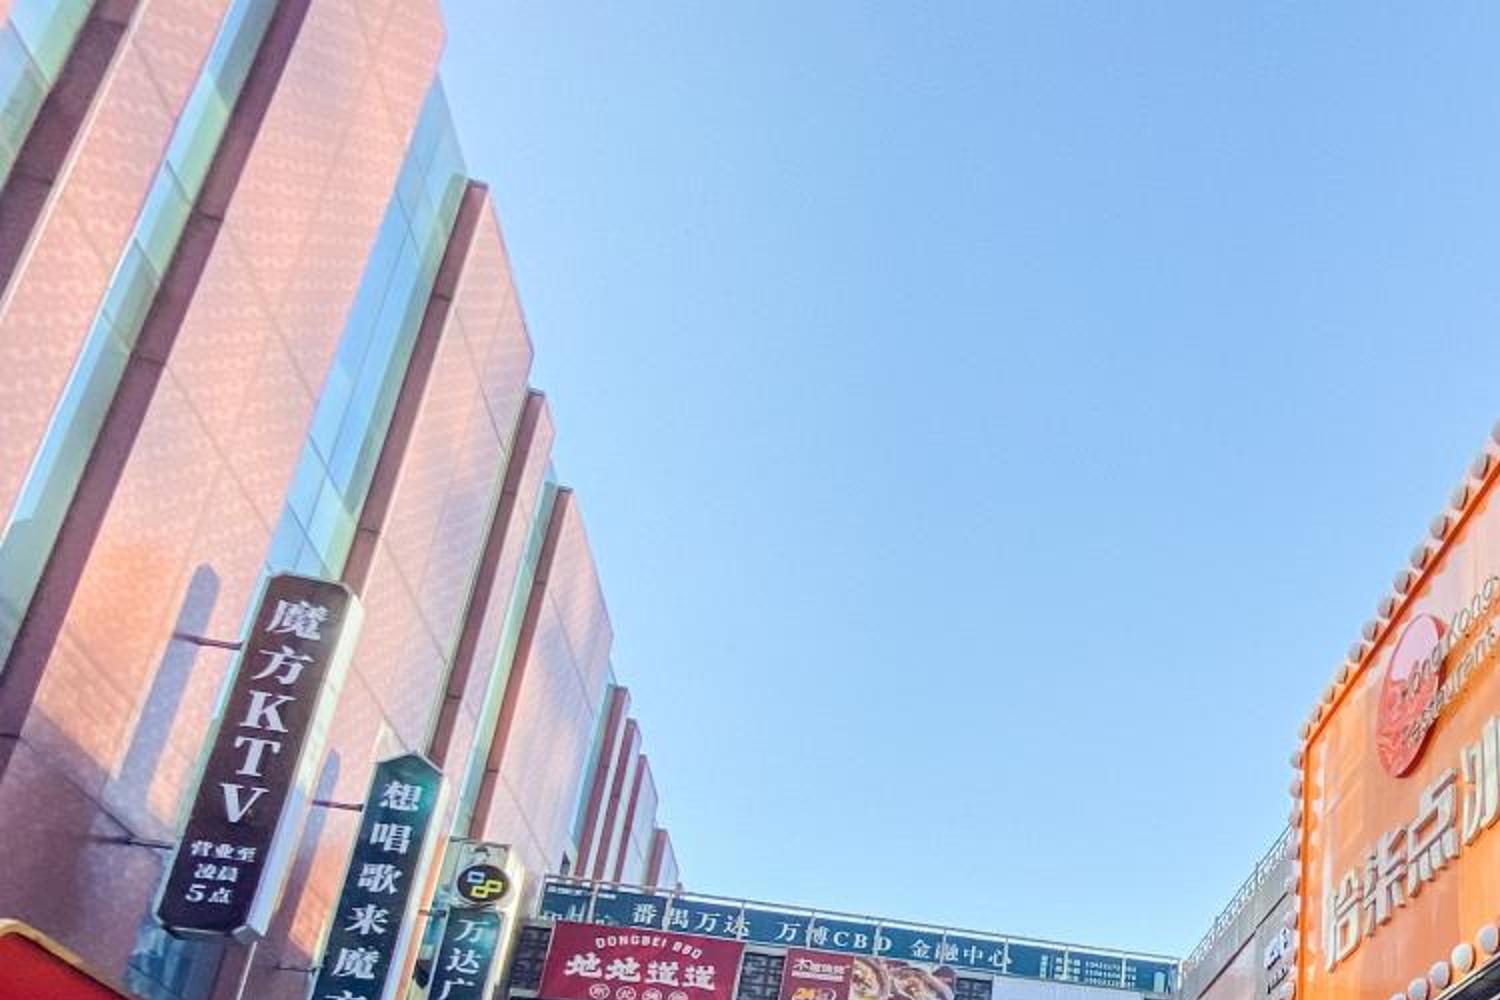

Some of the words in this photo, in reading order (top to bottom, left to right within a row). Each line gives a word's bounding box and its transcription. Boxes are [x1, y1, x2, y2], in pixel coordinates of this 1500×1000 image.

[220, 599, 329, 823] 魔方KTV
[191, 840, 257, 863] 营业至
[194, 863, 239, 882] 凌晨
[185, 884, 233, 904] 5点
[632, 902, 751, 937] 番禺万达
[776, 921, 893, 955] 万博CBD
[911, 938, 1013, 968] 金融中心
[565, 952, 716, 990] 地地道道
